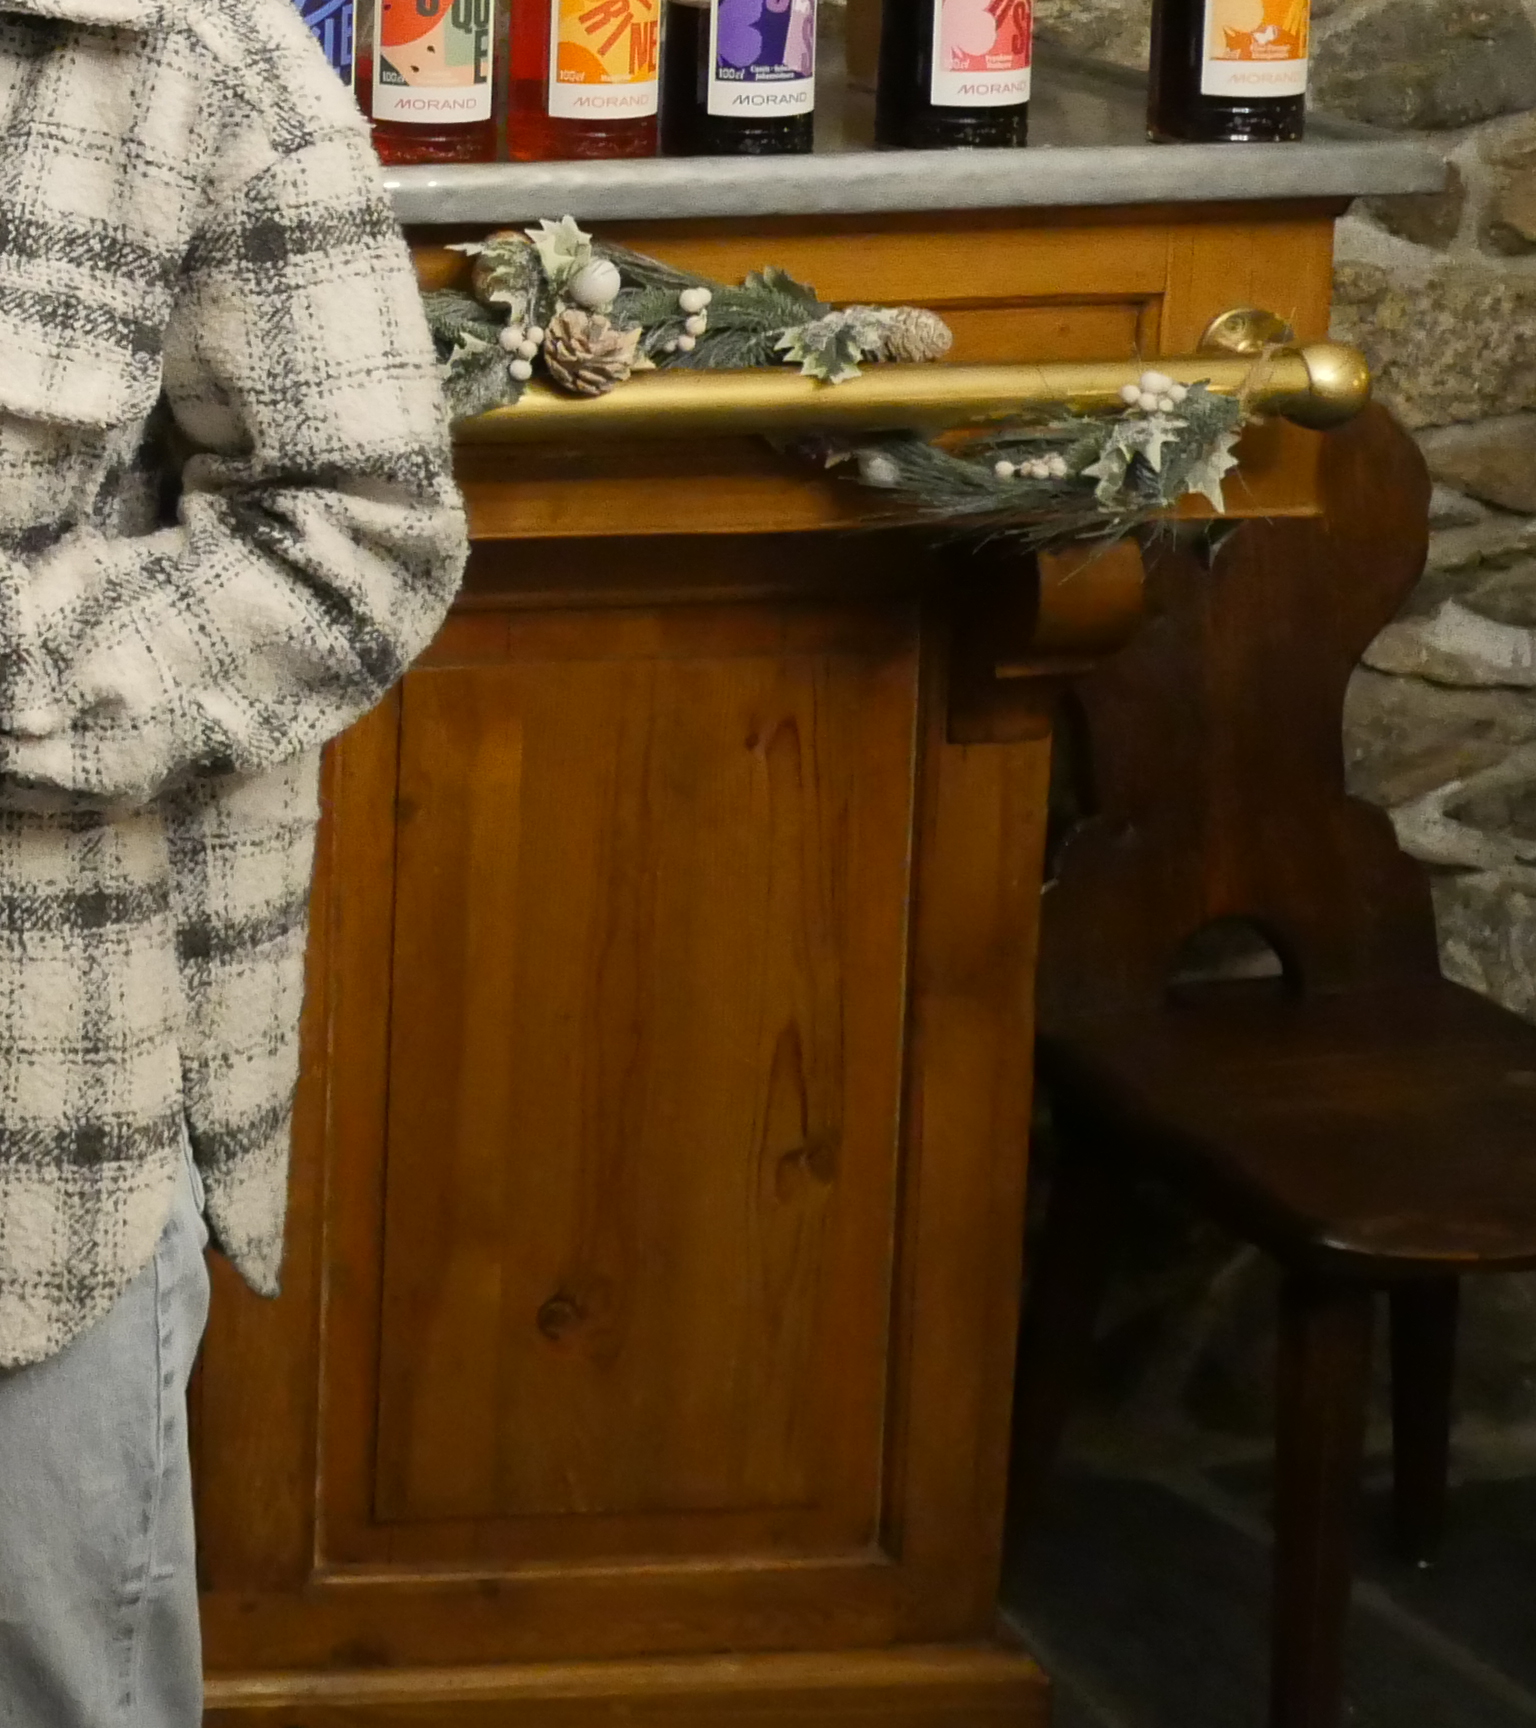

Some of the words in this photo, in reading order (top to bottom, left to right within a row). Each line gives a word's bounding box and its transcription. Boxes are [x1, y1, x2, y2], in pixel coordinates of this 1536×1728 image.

[394, 98, 477, 111] MORAND
[573, 94, 649, 108] MORAND
[732, 92, 807, 106] MORAND
